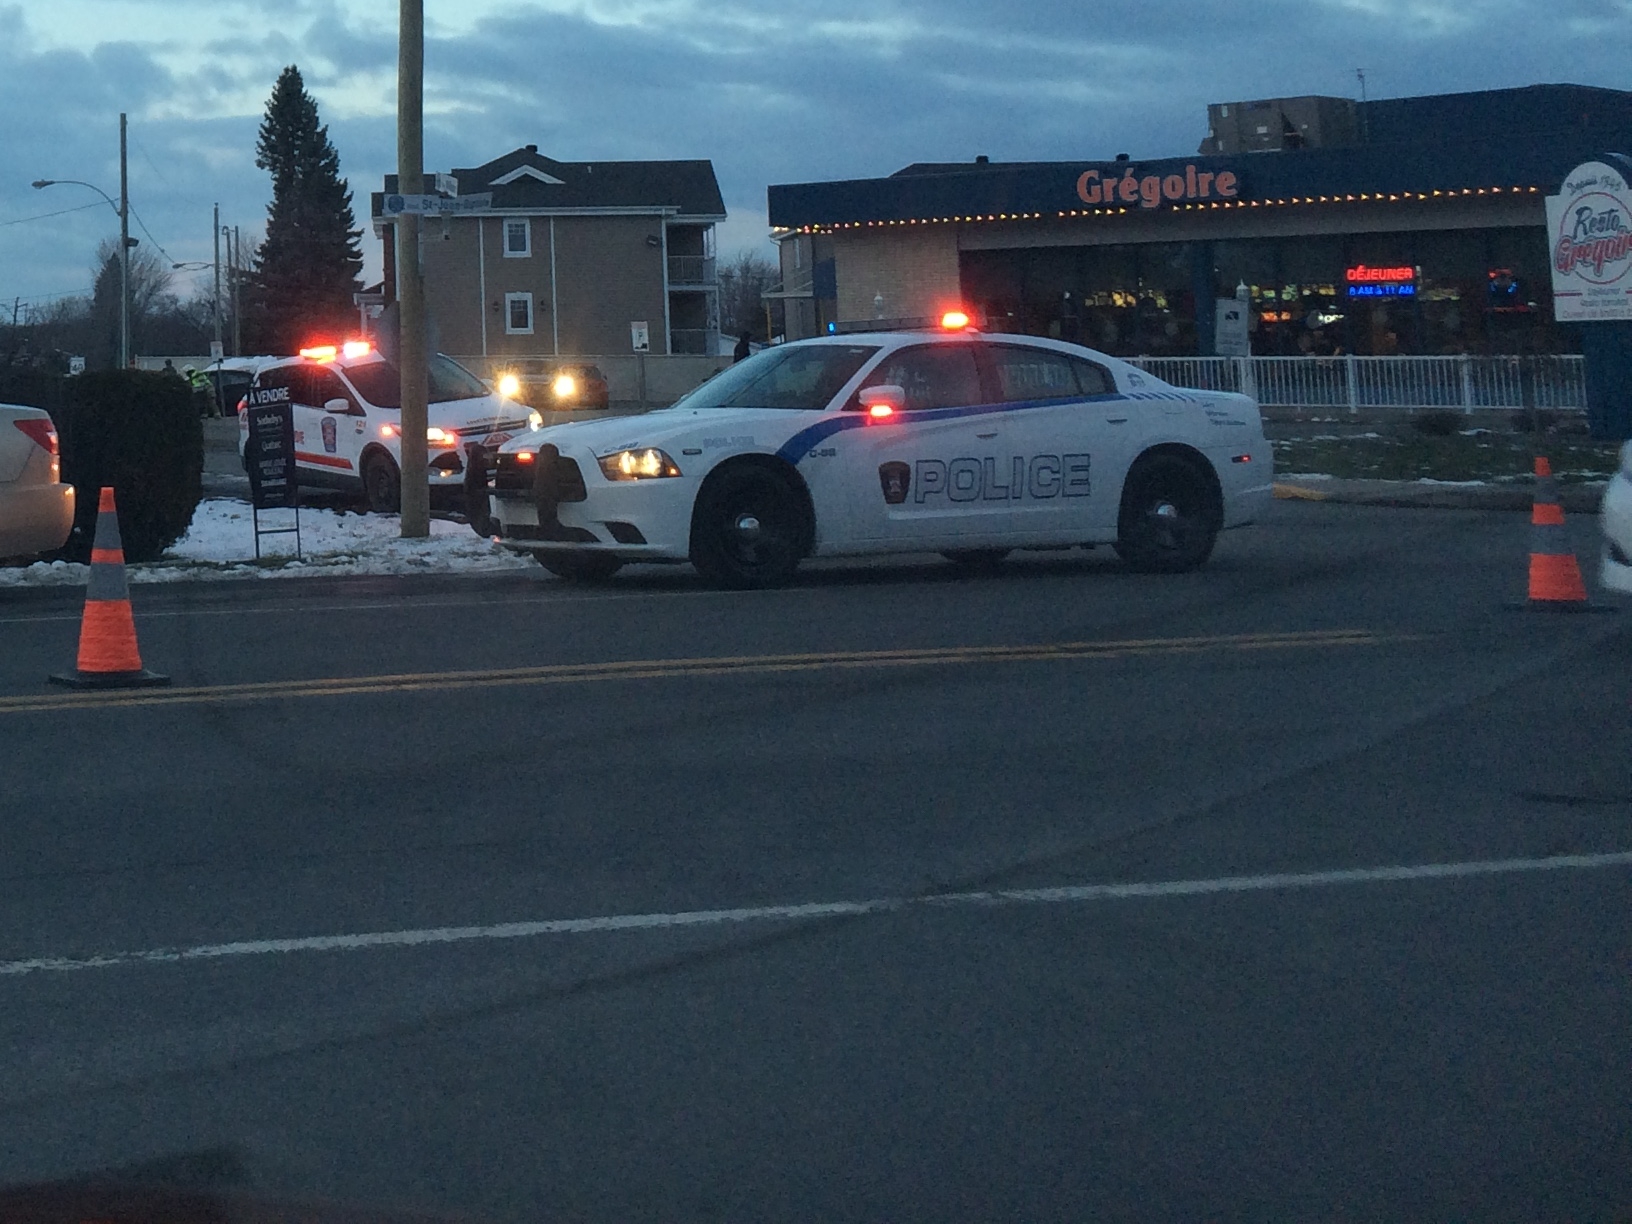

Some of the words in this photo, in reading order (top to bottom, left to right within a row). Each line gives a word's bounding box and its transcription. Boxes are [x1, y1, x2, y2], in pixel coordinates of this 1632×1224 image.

[1076, 164, 1239, 209] Grégoire
[1574, 206, 1620, 240] Resto
[1347, 265, 1413, 281] DÉJEUNER
[256, 386, 291, 404] VENDRE
[915, 453, 1091, 504] POLICE
